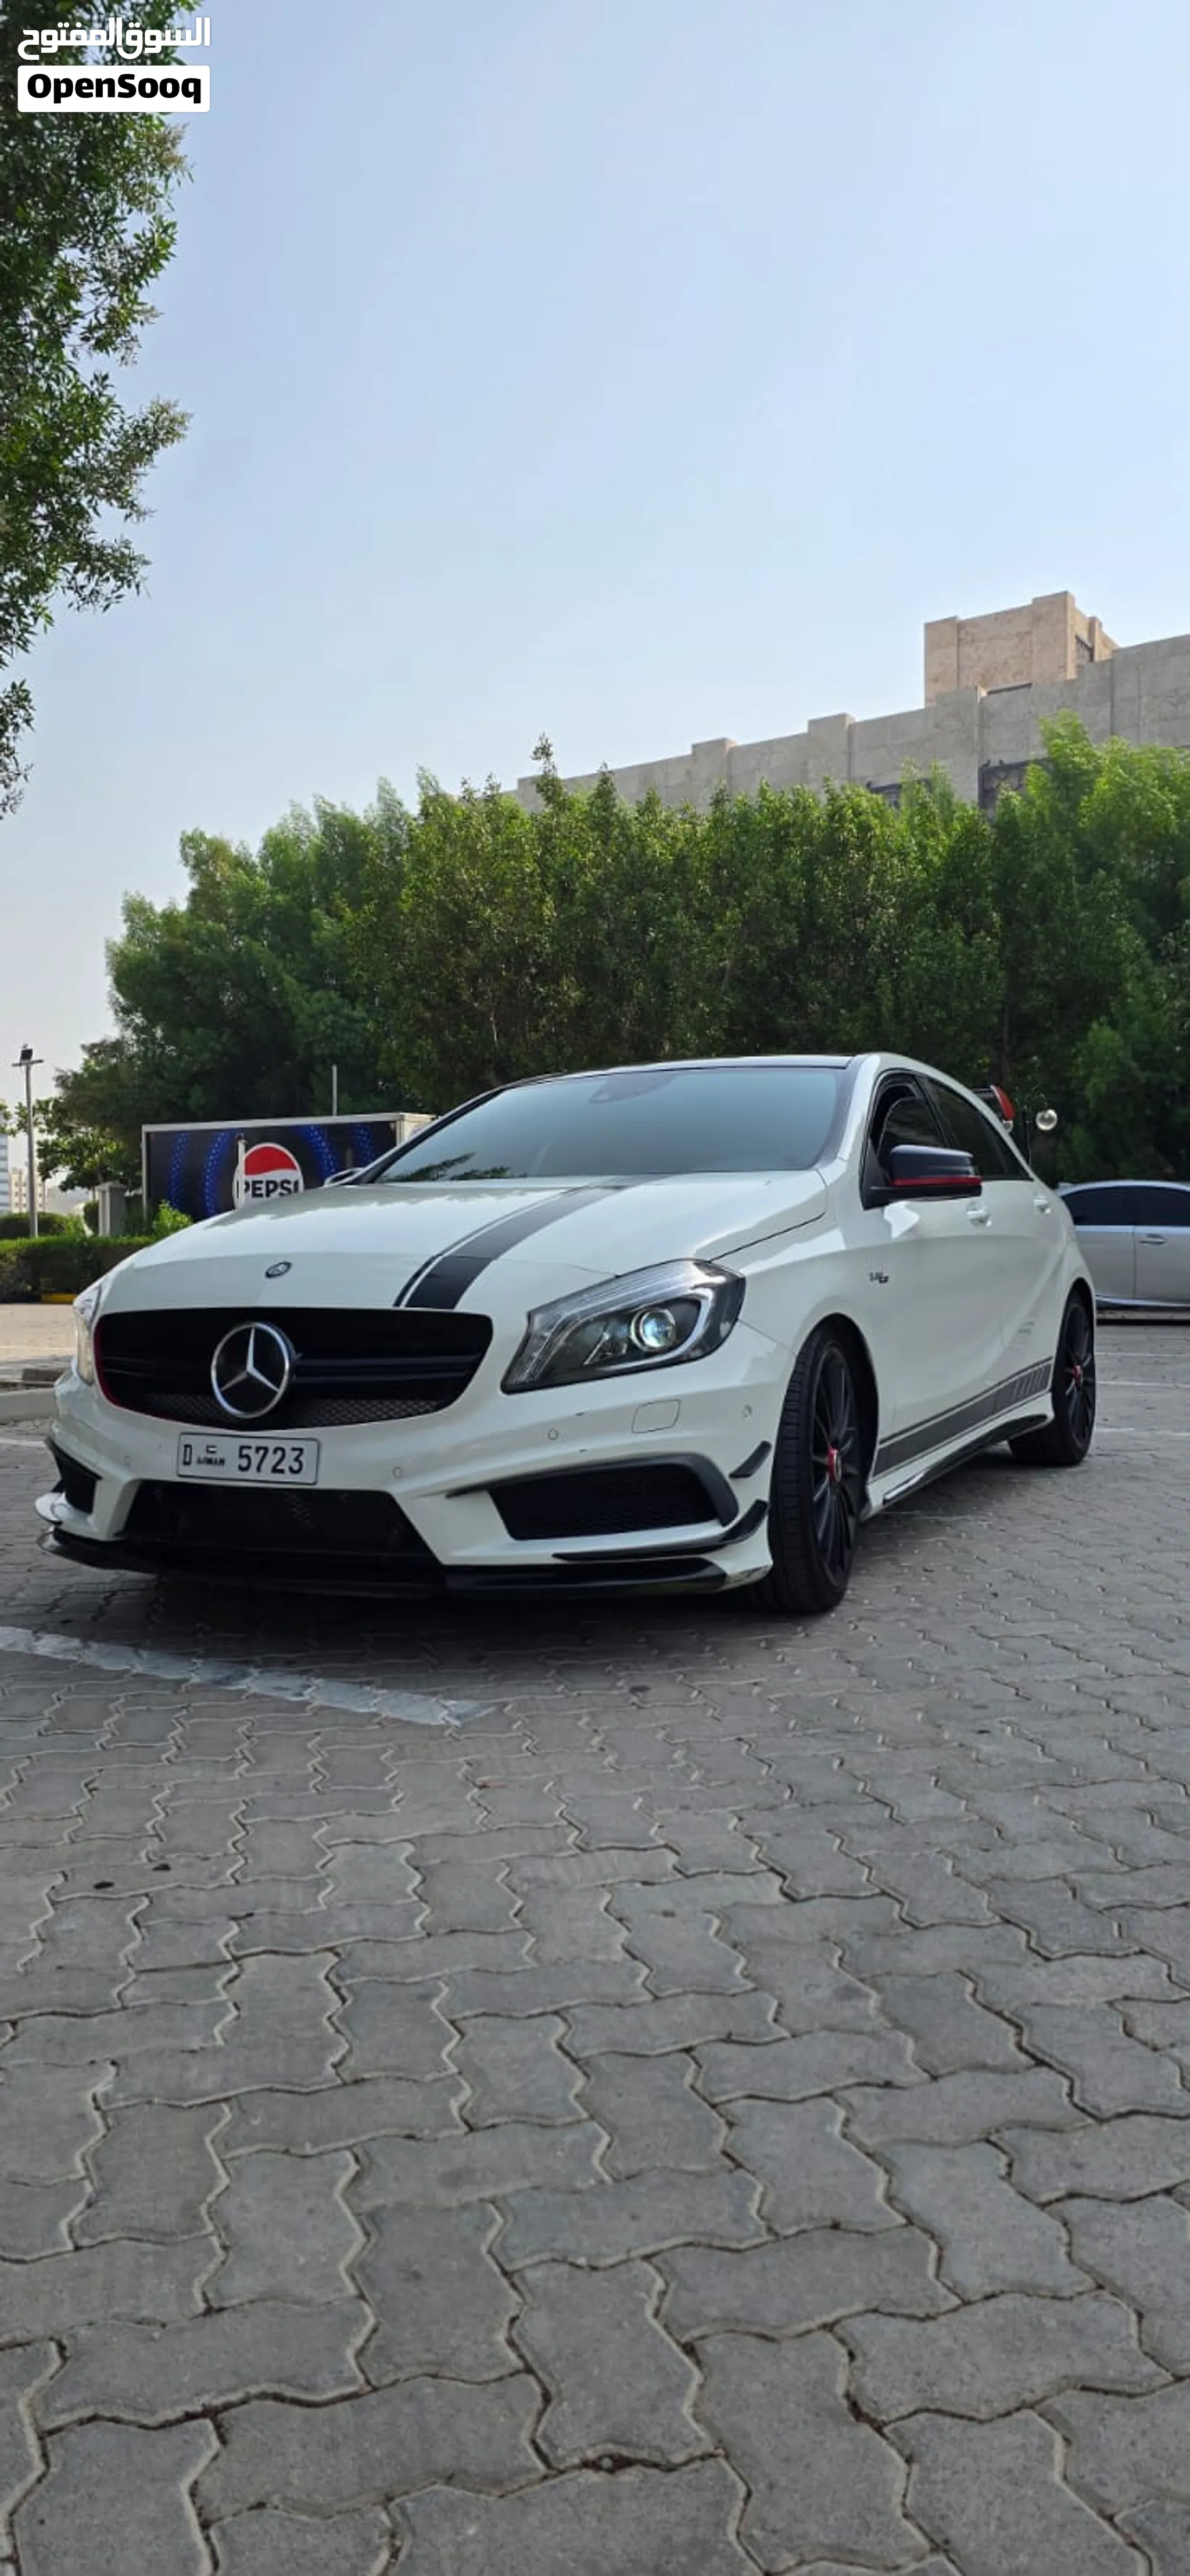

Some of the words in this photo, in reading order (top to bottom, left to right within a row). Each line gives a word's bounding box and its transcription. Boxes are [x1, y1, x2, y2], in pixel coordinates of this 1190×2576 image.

[236, 1179, 299, 1199] PEPSI
[182, 1444, 192, 1466] D
[238, 1445, 304, 1474] 5723
